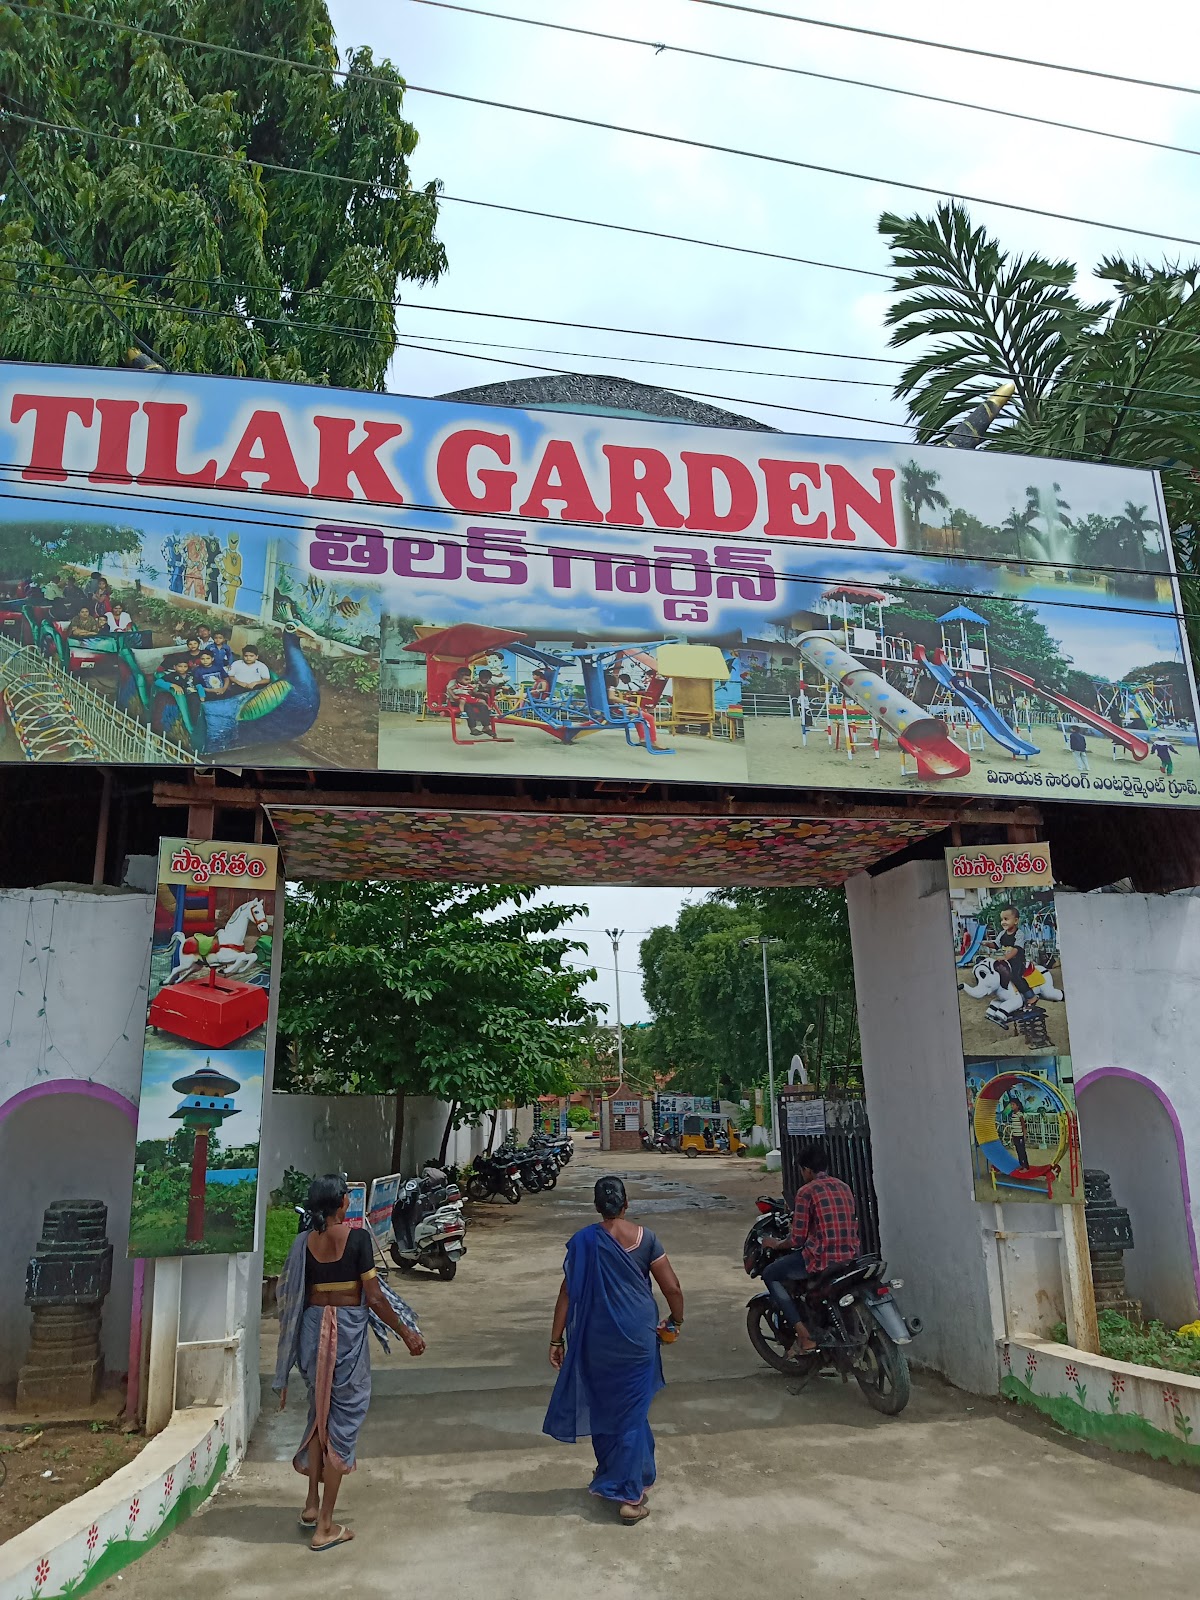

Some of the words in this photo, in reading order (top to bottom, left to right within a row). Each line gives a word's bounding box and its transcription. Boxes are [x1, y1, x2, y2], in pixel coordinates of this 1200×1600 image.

[10, 394, 403, 504] TILAK
[437, 429, 898, 547] GARDEN
[310, 524, 528, 585] తిలక్
[547, 545, 777, 623] గార్డెన్
[986, 769, 1043, 787] వినాయక
[1045, 772, 1091, 789] సారంగ్
[171, 847, 266, 882] స్వాగతం
[953, 853, 1047, 882] సుస్వాగతం
